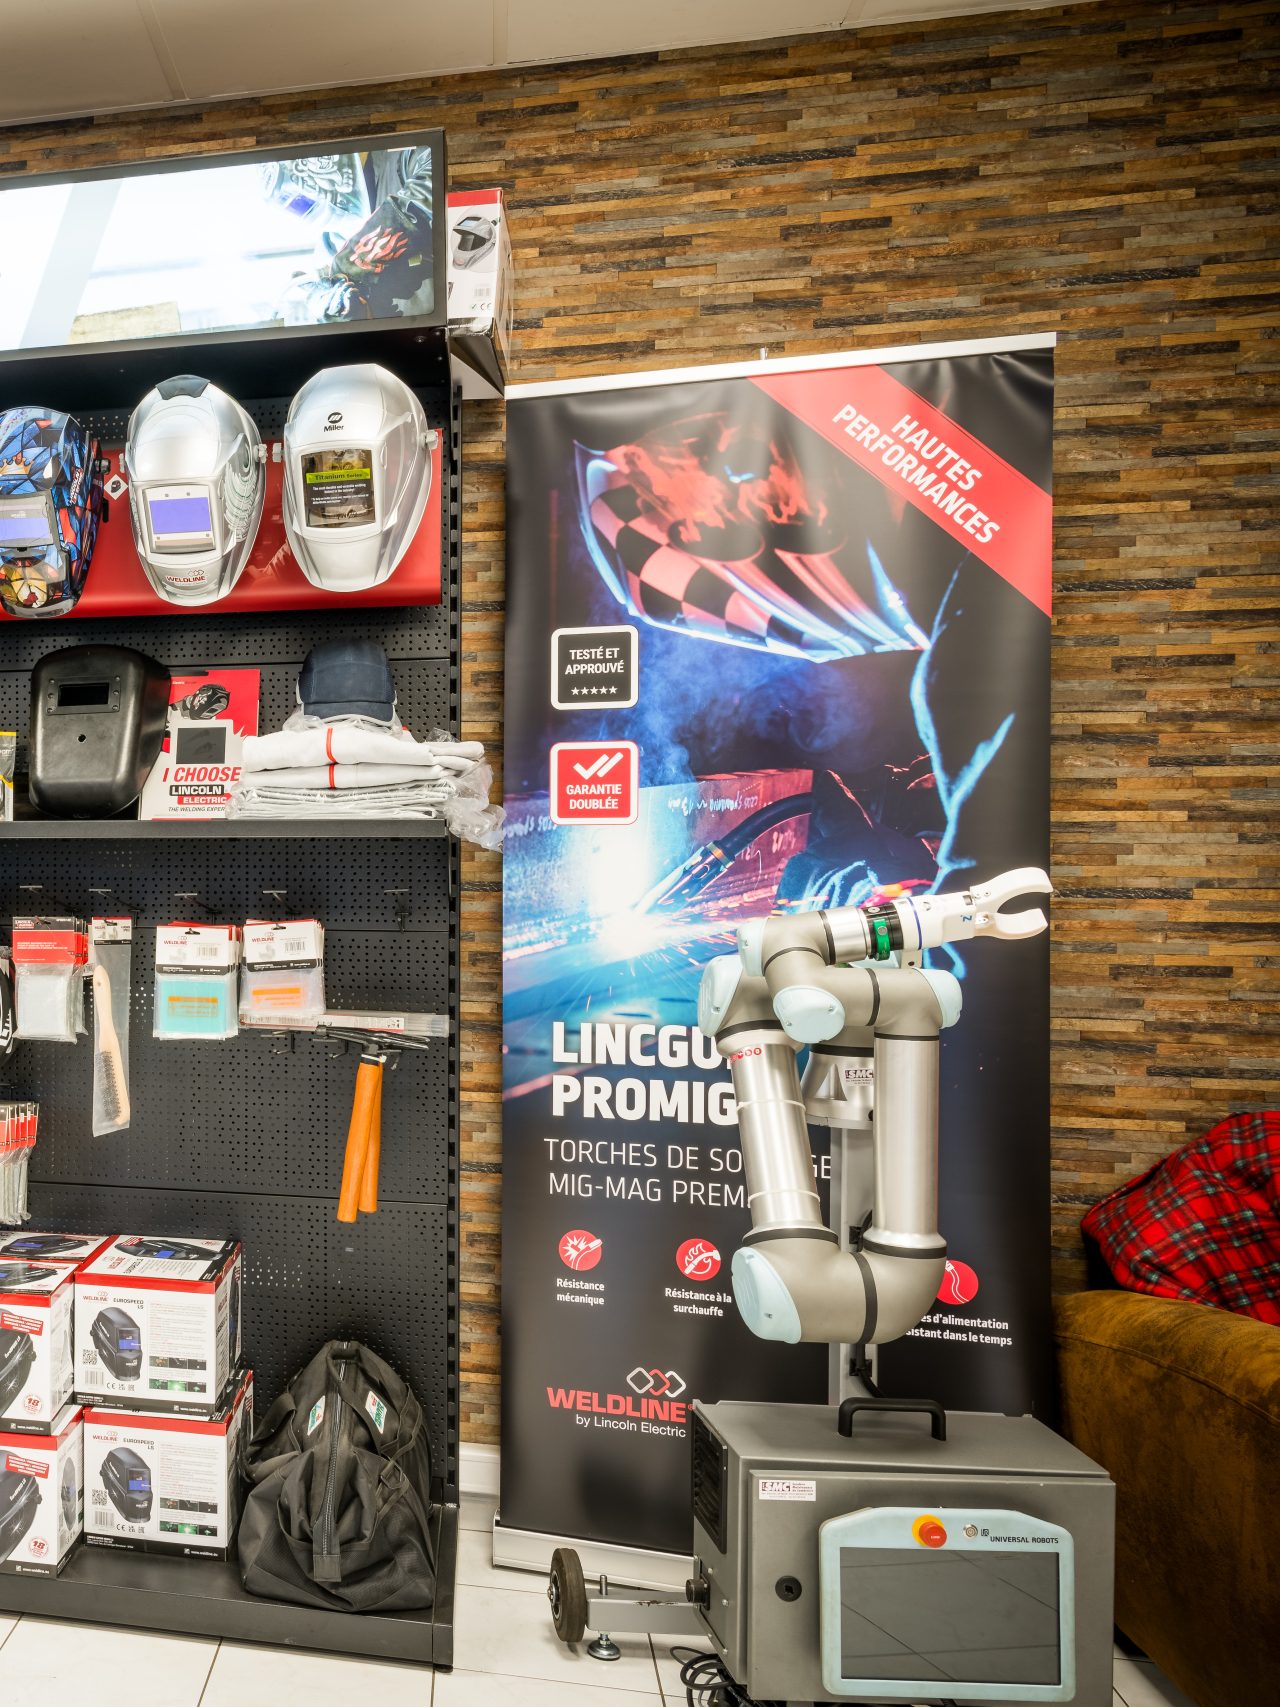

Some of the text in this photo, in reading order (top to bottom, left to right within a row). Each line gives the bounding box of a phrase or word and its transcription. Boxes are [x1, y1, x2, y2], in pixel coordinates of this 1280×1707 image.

[323, 424, 344, 432] Miller
[891, 414, 982, 491] HAUTES
[832, 404, 1001, 544] PERFORMANCES
[569, 646, 620, 660] TESTÉ ET
[565, 660, 625, 675] APPROUVÉ
[163, 767, 242, 782] I CHOOSE
[172, 786, 222, 795] LINCOLN
[566, 784, 622, 795] GARANTIE
[569, 796, 619, 810] DOUBLÉE
[552, 1022, 732, 1070] LINCGU
[552, 1074, 740, 1126] PROMIG
[544, 1138, 658, 1167] TORCHES
[668, 1146, 699, 1170] DE
[549, 1172, 662, 1202] MIG-MAG
[557, 1277, 605, 1291] Résistance
[556, 1292, 605, 1306] mécanique
[665, 1287, 732, 1303] Résistance à la
[673, 1303, 724, 1317] surchauffe
[933, 1313, 1009, 1330] d'alimentation
[943, 1329, 967, 1341] dans
[968, 1331, 978, 1343] le
[979, 1333, 1013, 1347] temps
[27, 1397, 40, 1407] 18
[575, 1414, 687, 1438] by Lincoln Electric
[33, 1541, 46, 1550] 18
[1032, 1536, 1059, 1544] ROBOTS
